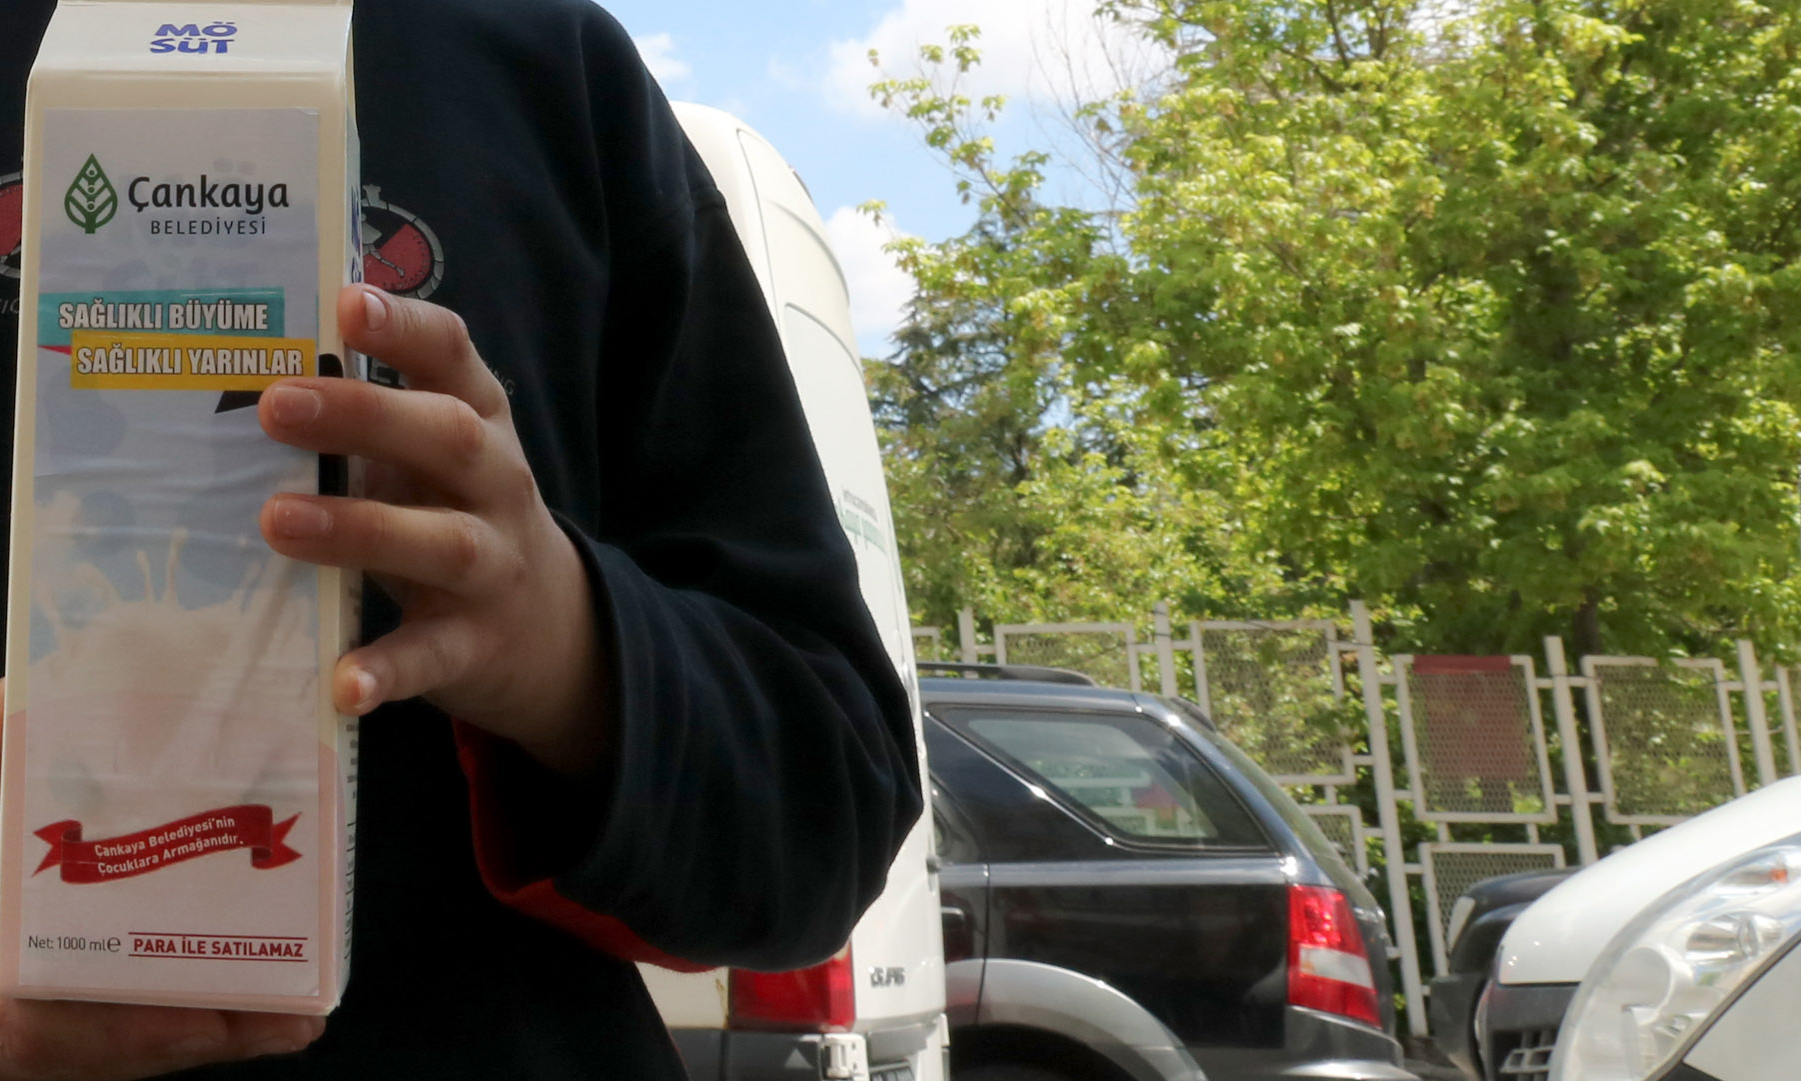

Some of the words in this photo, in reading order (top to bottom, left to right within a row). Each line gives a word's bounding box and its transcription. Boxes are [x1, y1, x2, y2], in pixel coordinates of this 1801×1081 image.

[154, 21, 238, 37] MÖ
[149, 37, 235, 54] SÜT
[128, 174, 289, 215] Çankaya
[151, 216, 266, 235] BELEDİYESİ
[58, 298, 163, 330] SAĞLIKLI
[168, 299, 269, 331] BÜYÜME
[76, 342, 182, 374] SAĞLIKLI
[188, 348, 304, 376] YARINLAR
[97, 854, 160, 877] Çocuklara
[28, 936, 54, 951] Net:
[57, 936, 86, 951] 1000
[133, 938, 177, 954] PARA
[181, 936, 206, 955] İLE
[211, 941, 304, 958] SATILAMAZ
